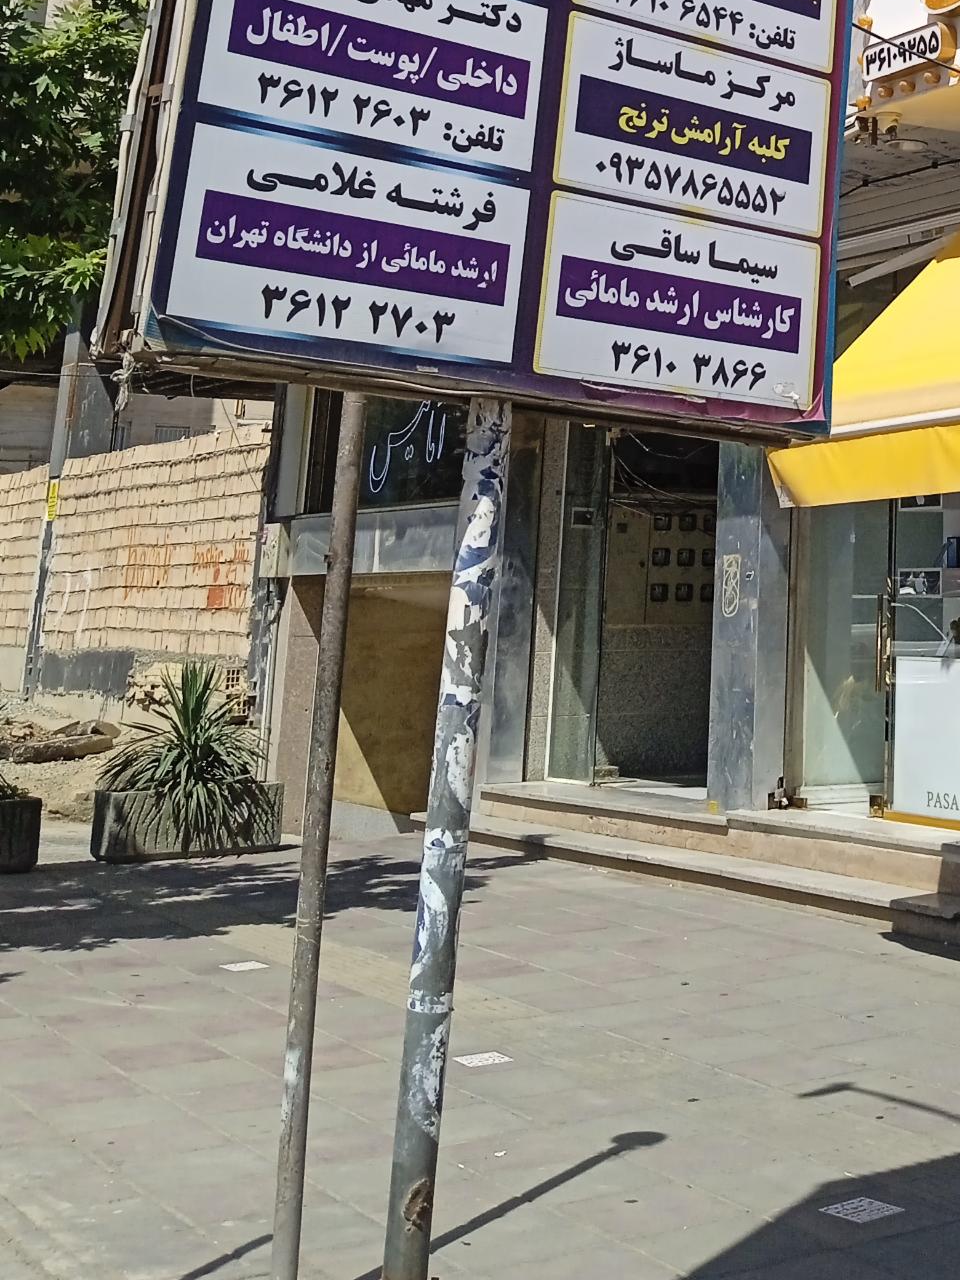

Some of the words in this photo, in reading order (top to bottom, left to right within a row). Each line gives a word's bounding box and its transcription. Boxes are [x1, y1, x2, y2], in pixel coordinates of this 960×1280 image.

[438, 2, 522, 33] دکتر
[748, 23, 796, 50] تلفن:
[607, 36, 716, 86] ماساژ
[257, 72, 339, 118] ۳۶۱۲
[720, 70, 796, 112] مرکز
[352, 93, 431, 136] ۲۶۰۳
[617, 102, 670, 139] ترنج
[443, 121, 505, 153] تلفن:
[670, 115, 747, 156] آرامش
[747, 135, 792, 163] کلبه
[246, 161, 377, 199] غلامی
[386, 183, 498, 232] فرشته
[205, 214, 269, 248] تهران
[273, 225, 353, 258] دانشگاه
[610, 228, 701, 265] ساقی
[356, 240, 378, 269] از
[708, 240, 778, 284] سیما
[261, 283, 352, 329] ۳۶۱۲
[368, 300, 456, 343] ۲۷۰۳
[646, 286, 700, 325] ارشد
[703, 298, 795, 339] کارشناس
[611, 339, 678, 378] ۳۶۱۰
[693, 352, 767, 391] ۳۸۶۶
